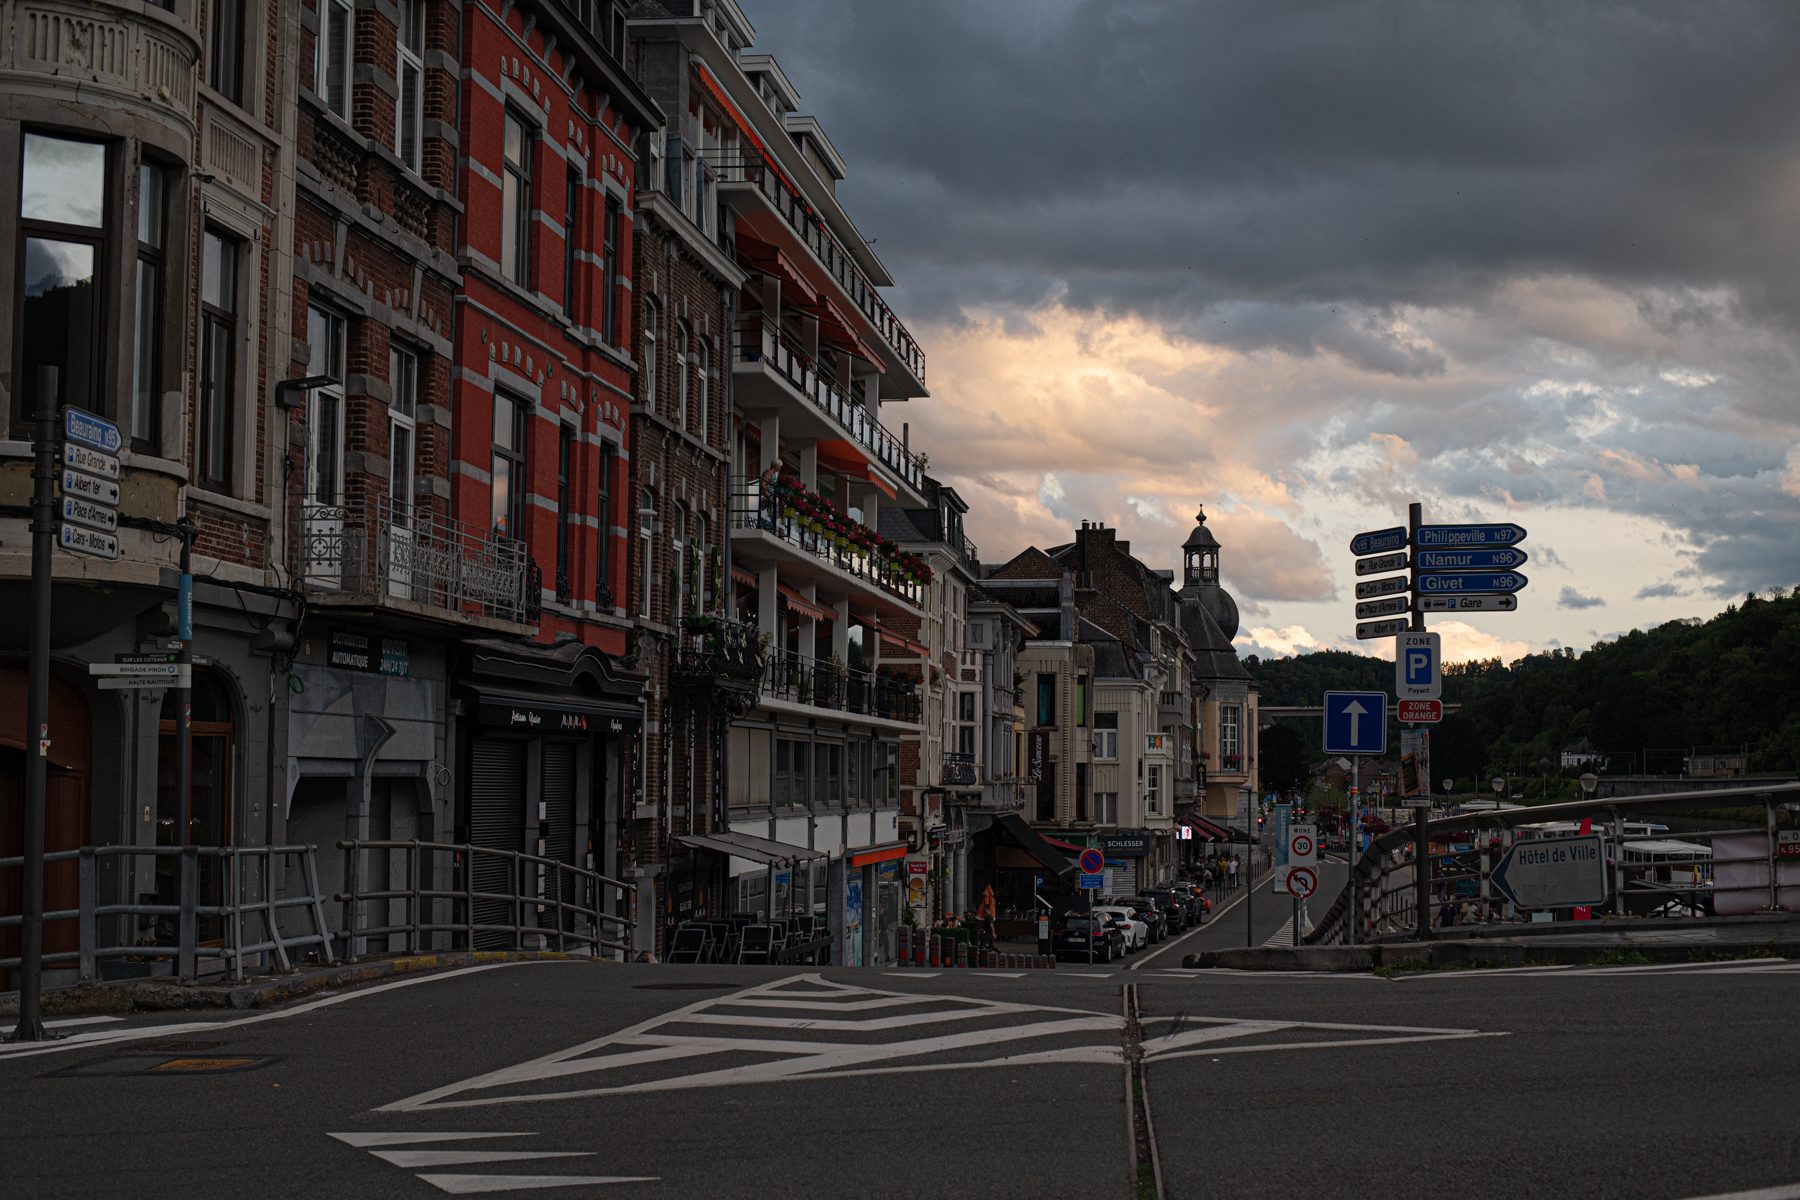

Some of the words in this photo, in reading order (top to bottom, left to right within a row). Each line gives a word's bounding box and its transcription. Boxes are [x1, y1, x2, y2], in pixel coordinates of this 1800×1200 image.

[70, 414, 102, 447] Beauraing
[76, 448, 86, 465] Rue
[87, 452, 106, 470] Grande
[74, 476, 92, 492] Albert
[92, 480, 100, 494] 1er
[74, 501, 87, 518] Place
[88, 506, 107, 524] d'Armes
[72, 528, 85, 546] Cars
[89, 534, 105, 550] Motos
[1370, 534, 1400, 549] Beauraing
[1425, 530, 1486, 545] Philippeville
[1494, 530, 1512, 540] N97
[1369, 561, 1378, 570] Rue
[1378, 558, 1395, 569] Grande
[1425, 554, 1472, 565] Namur
[1493, 553, 1512, 563] N96
[1366, 584, 1377, 594] Cars
[1381, 582, 1396, 592] Motos
[1426, 577, 1463, 589] Givet
[1493, 576, 1513, 587] N96
[1366, 605, 1378, 615] Place
[1378, 602, 1396, 612] d'Armes
[1460, 598, 1482, 608] Gare
[1374, 624, 1388, 634] Albert
[332, 632, 368, 648] DISTRIBUTEUR
[382, 638, 408, 656] OUVERT
[1406, 638, 1431, 646] ZONE
[332, 652, 368, 668] AUTOMATIQUE
[1032, 768, 1042, 781] Le
[1519, 848, 1549, 865] Hôtel
[1553, 848, 1566, 862] de
[1569, 845, 1596, 861] Ville
